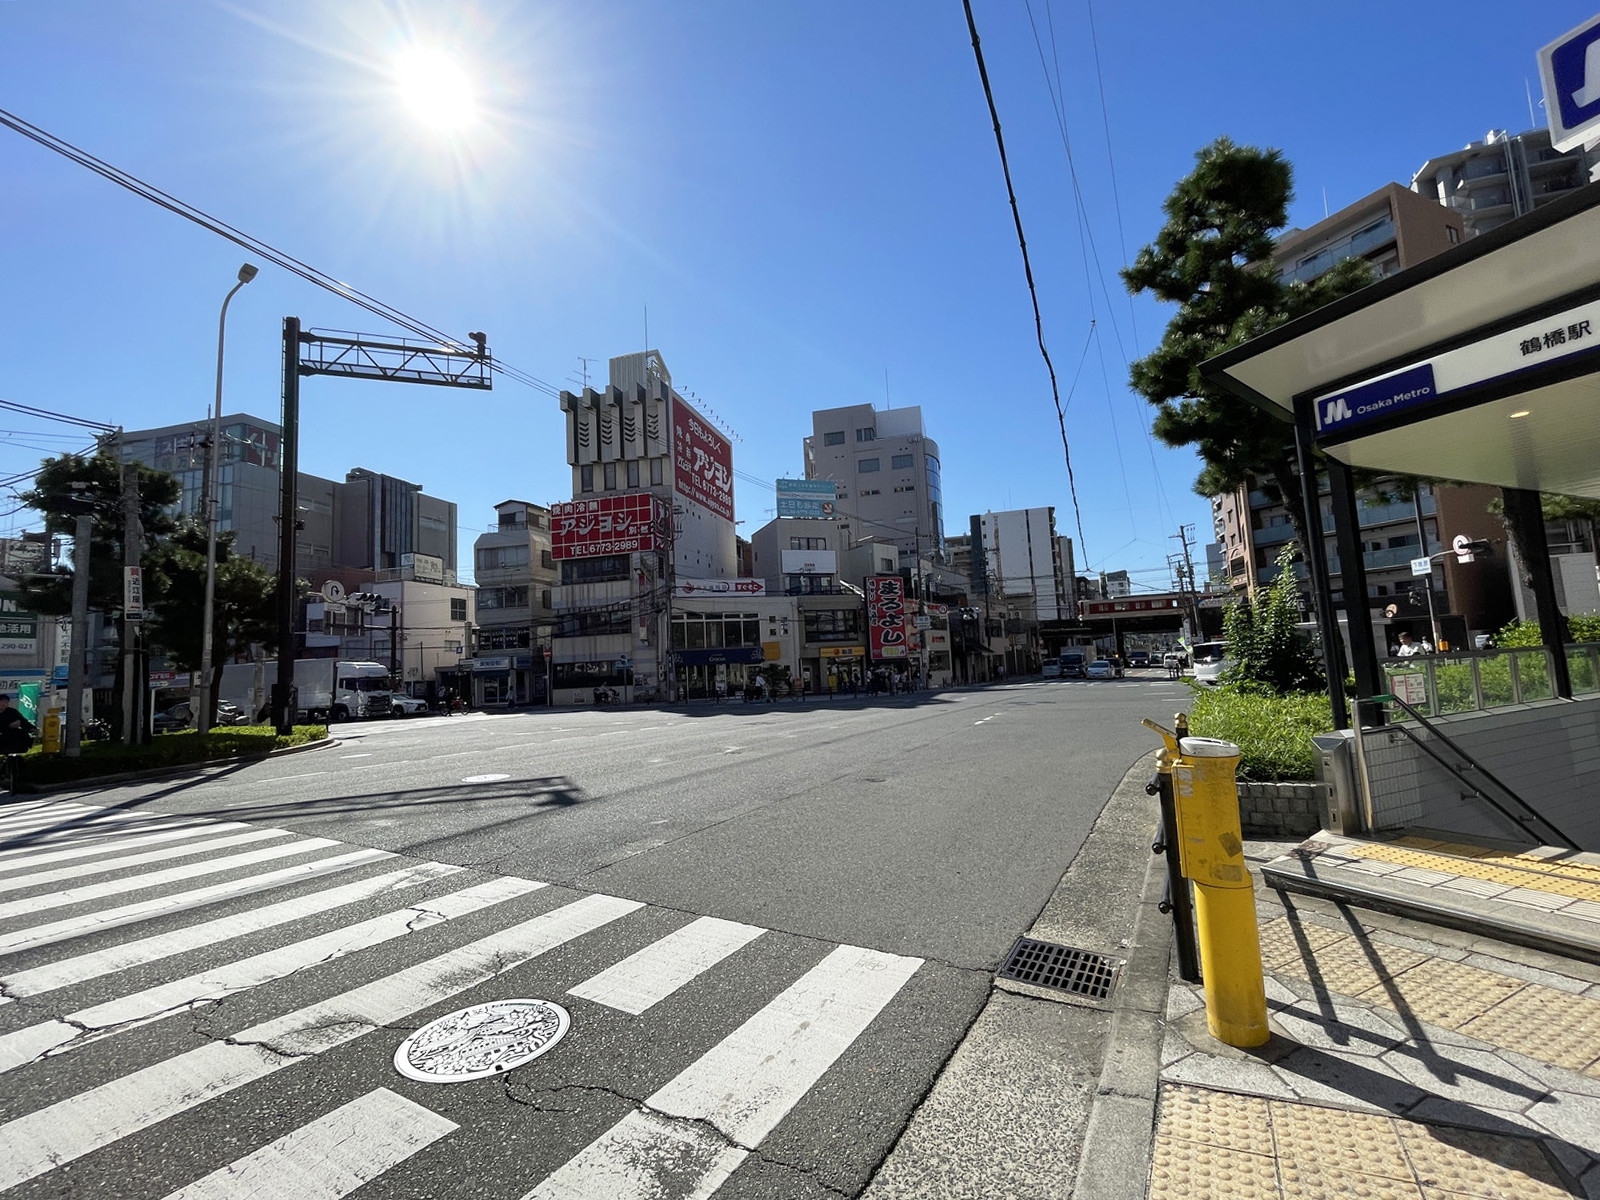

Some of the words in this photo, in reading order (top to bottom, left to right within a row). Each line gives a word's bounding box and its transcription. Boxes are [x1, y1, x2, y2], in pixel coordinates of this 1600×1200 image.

[1519, 319, 1592, 357] 鶴橋駅
[1356, 399, 1392, 414] Osaka
[1393, 386, 1430, 404] Metro
[693, 446, 732, 493] アジヨシ
[560, 512, 633, 537] アジヨシ
[570, 546, 588, 556] TEL
[589, 540, 638, 554] 6773-2989
[879, 580, 904, 645] まるよし
